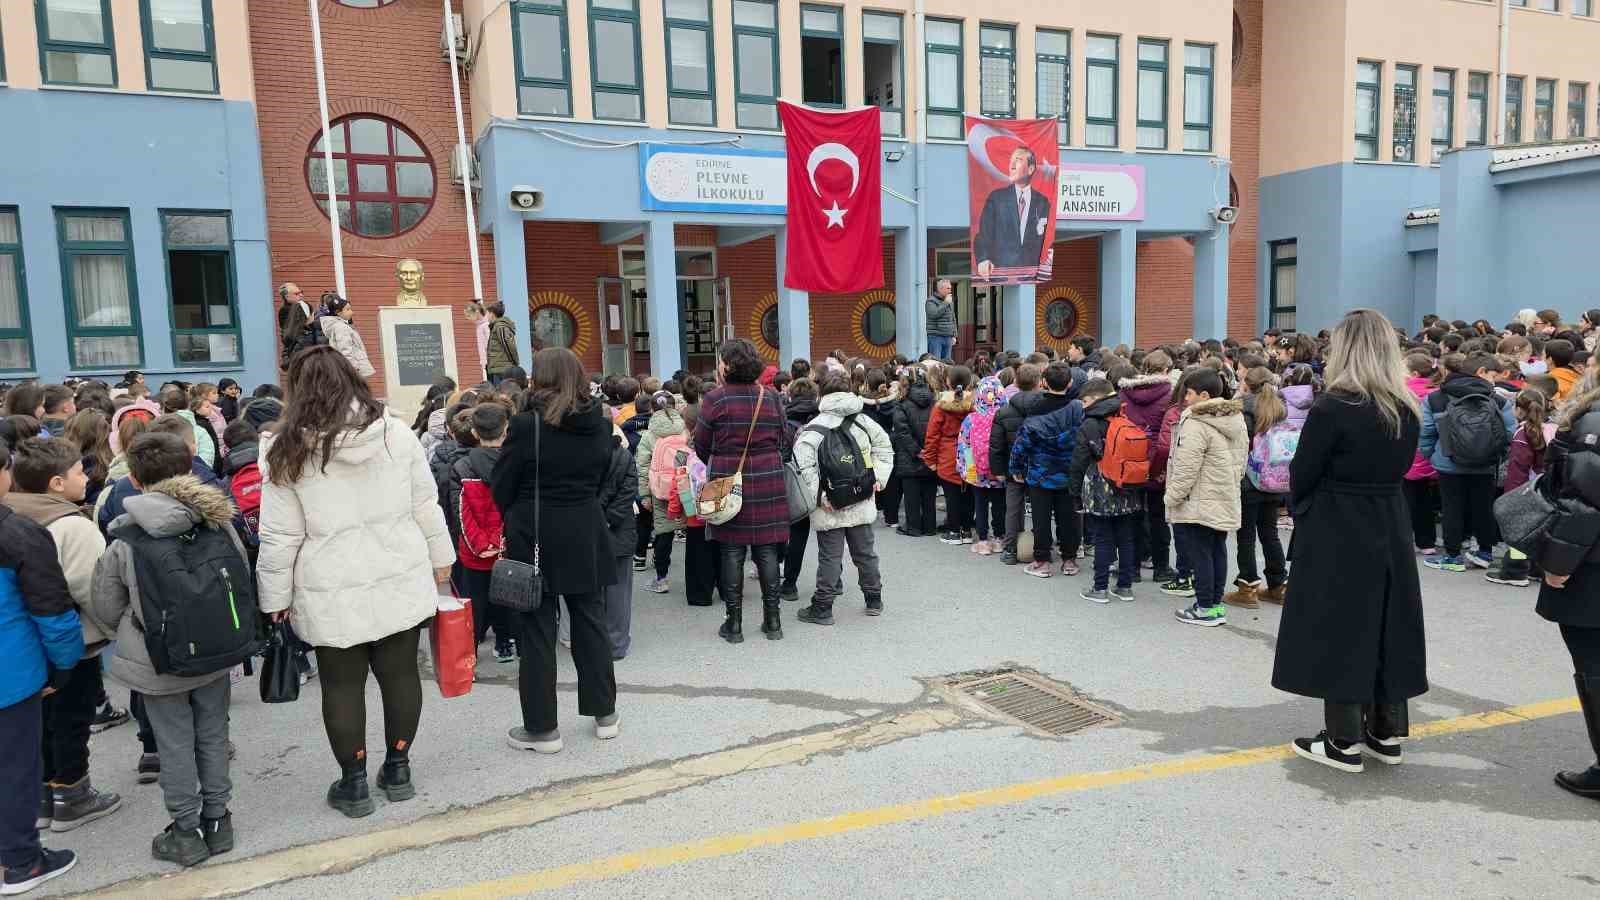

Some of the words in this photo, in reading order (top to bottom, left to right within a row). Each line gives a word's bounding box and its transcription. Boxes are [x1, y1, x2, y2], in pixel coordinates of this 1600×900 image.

[696, 171, 749, 185] PLEVNE
[697, 184, 764, 201] İLKOKULU
[1061, 184, 1105, 197] PLEVNE
[1062, 200, 1121, 213] ANASINIFI
